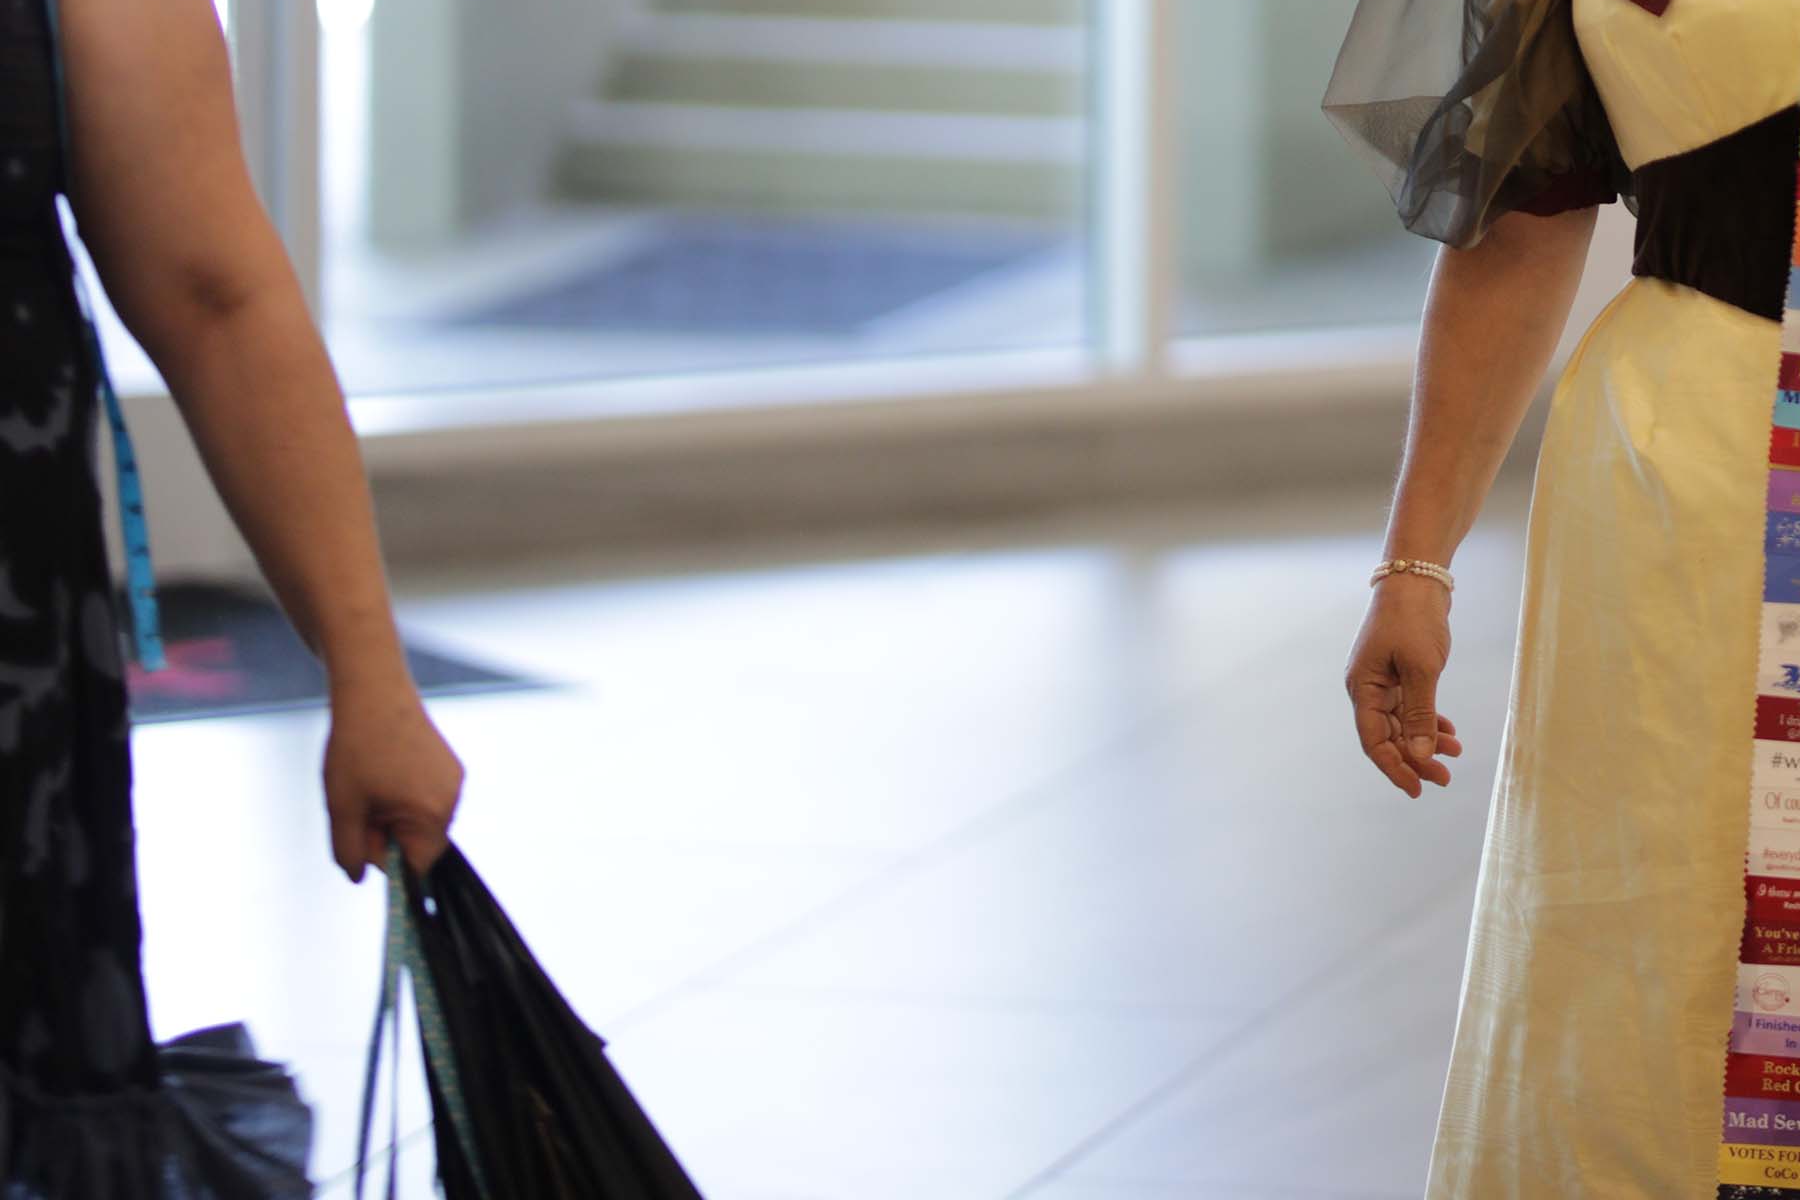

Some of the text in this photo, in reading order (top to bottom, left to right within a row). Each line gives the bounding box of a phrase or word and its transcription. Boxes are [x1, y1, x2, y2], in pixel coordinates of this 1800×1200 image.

[1779, 714, 1785, 725] I
[1764, 792, 1782, 810] Of
[1754, 926, 1800, 940] You've
[1762, 944, 1773, 953] A
[1748, 1017, 1752, 1027] I
[1785, 1038, 1797, 1048] In
[1762, 1078, 1791, 1092] Red
[1728, 1112, 1768, 1129] Mad
[1729, 1147, 1775, 1161] VOTES
[1764, 1167, 1798, 1180] CoCo
